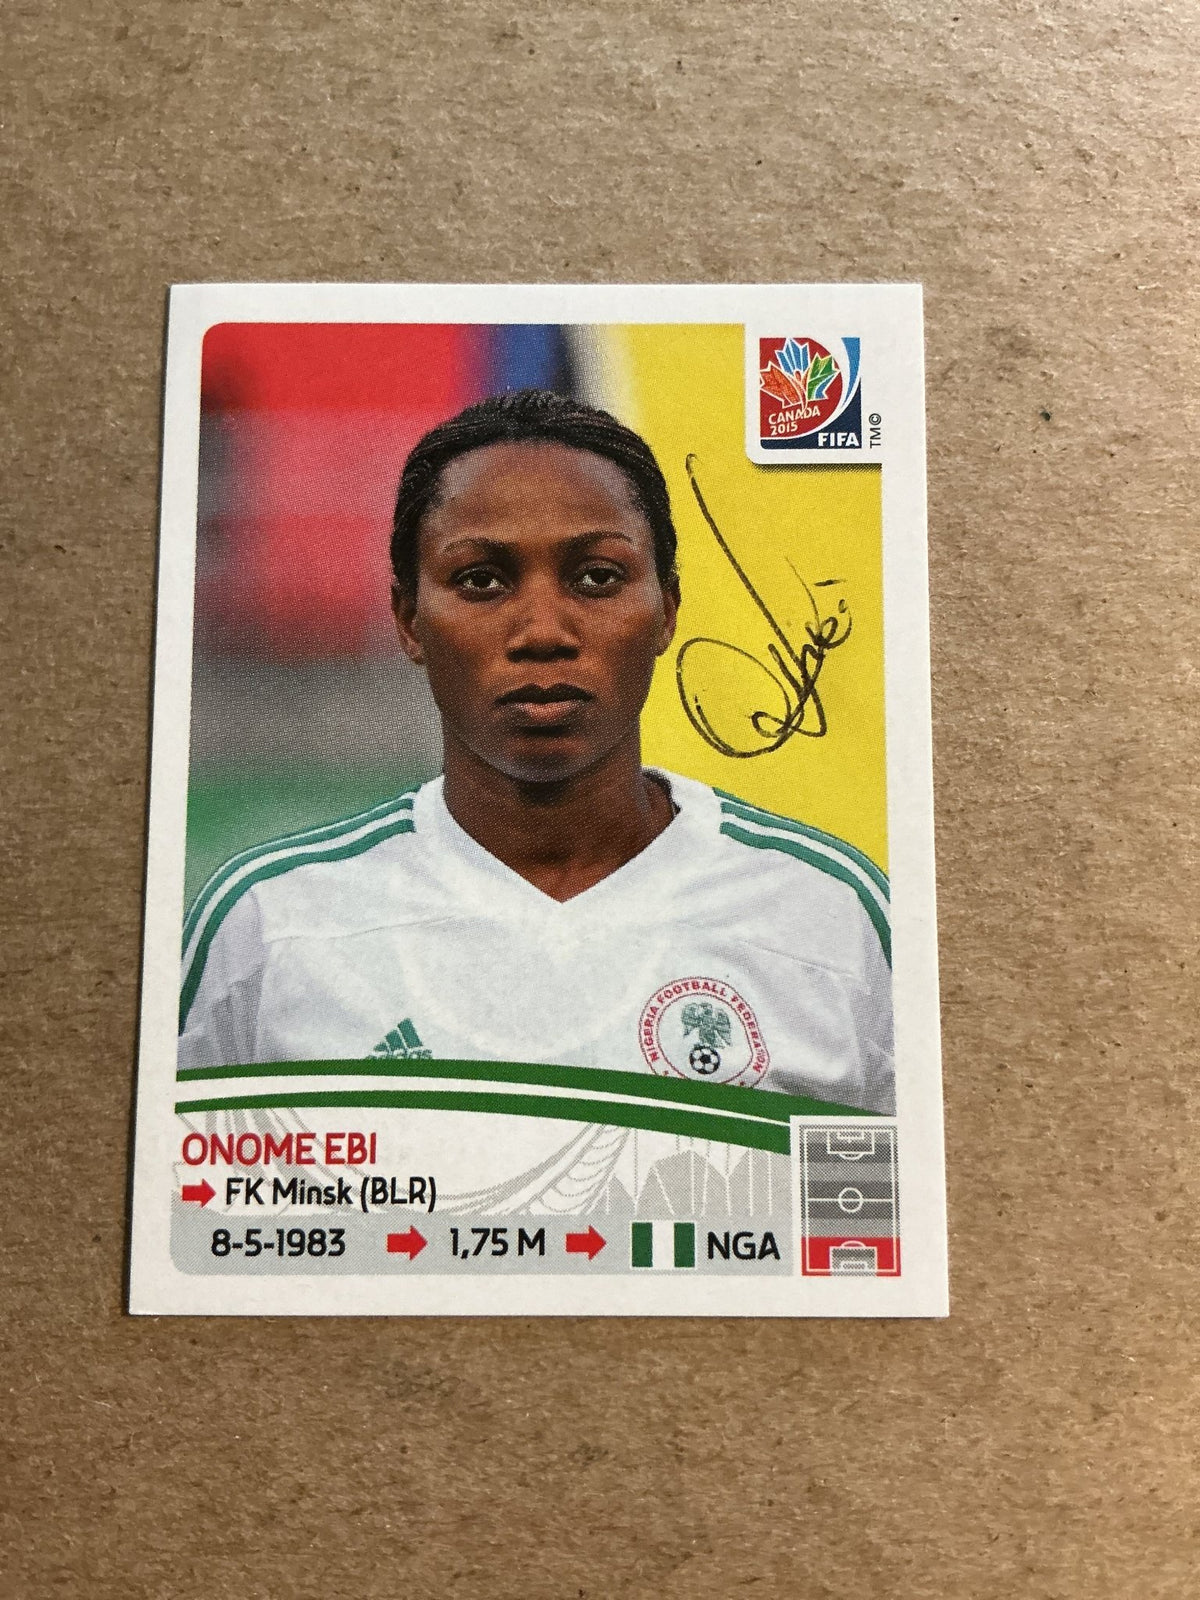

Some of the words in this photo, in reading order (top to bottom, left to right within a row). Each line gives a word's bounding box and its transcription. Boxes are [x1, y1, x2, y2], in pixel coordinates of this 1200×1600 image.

[768, 405, 820, 424] CANADA
[770, 421, 798, 436] 2015
[818, 432, 860, 447] FIFA
[643, 1005, 660, 1063] NIGERIA
[656, 980, 728, 1005] FOOTBALL
[182, 1132, 317, 1166] ONOME
[325, 1132, 377, 1165] EBI
[226, 1177, 265, 1205] FK
[272, 1176, 354, 1205] Minsk
[360, 1176, 437, 1213] (BLR)
[211, 1228, 346, 1257] 8-5-1983
[450, 1228, 509, 1259] 1,75
[518, 1228, 546, 1257] M
[707, 1231, 781, 1260] NGA
